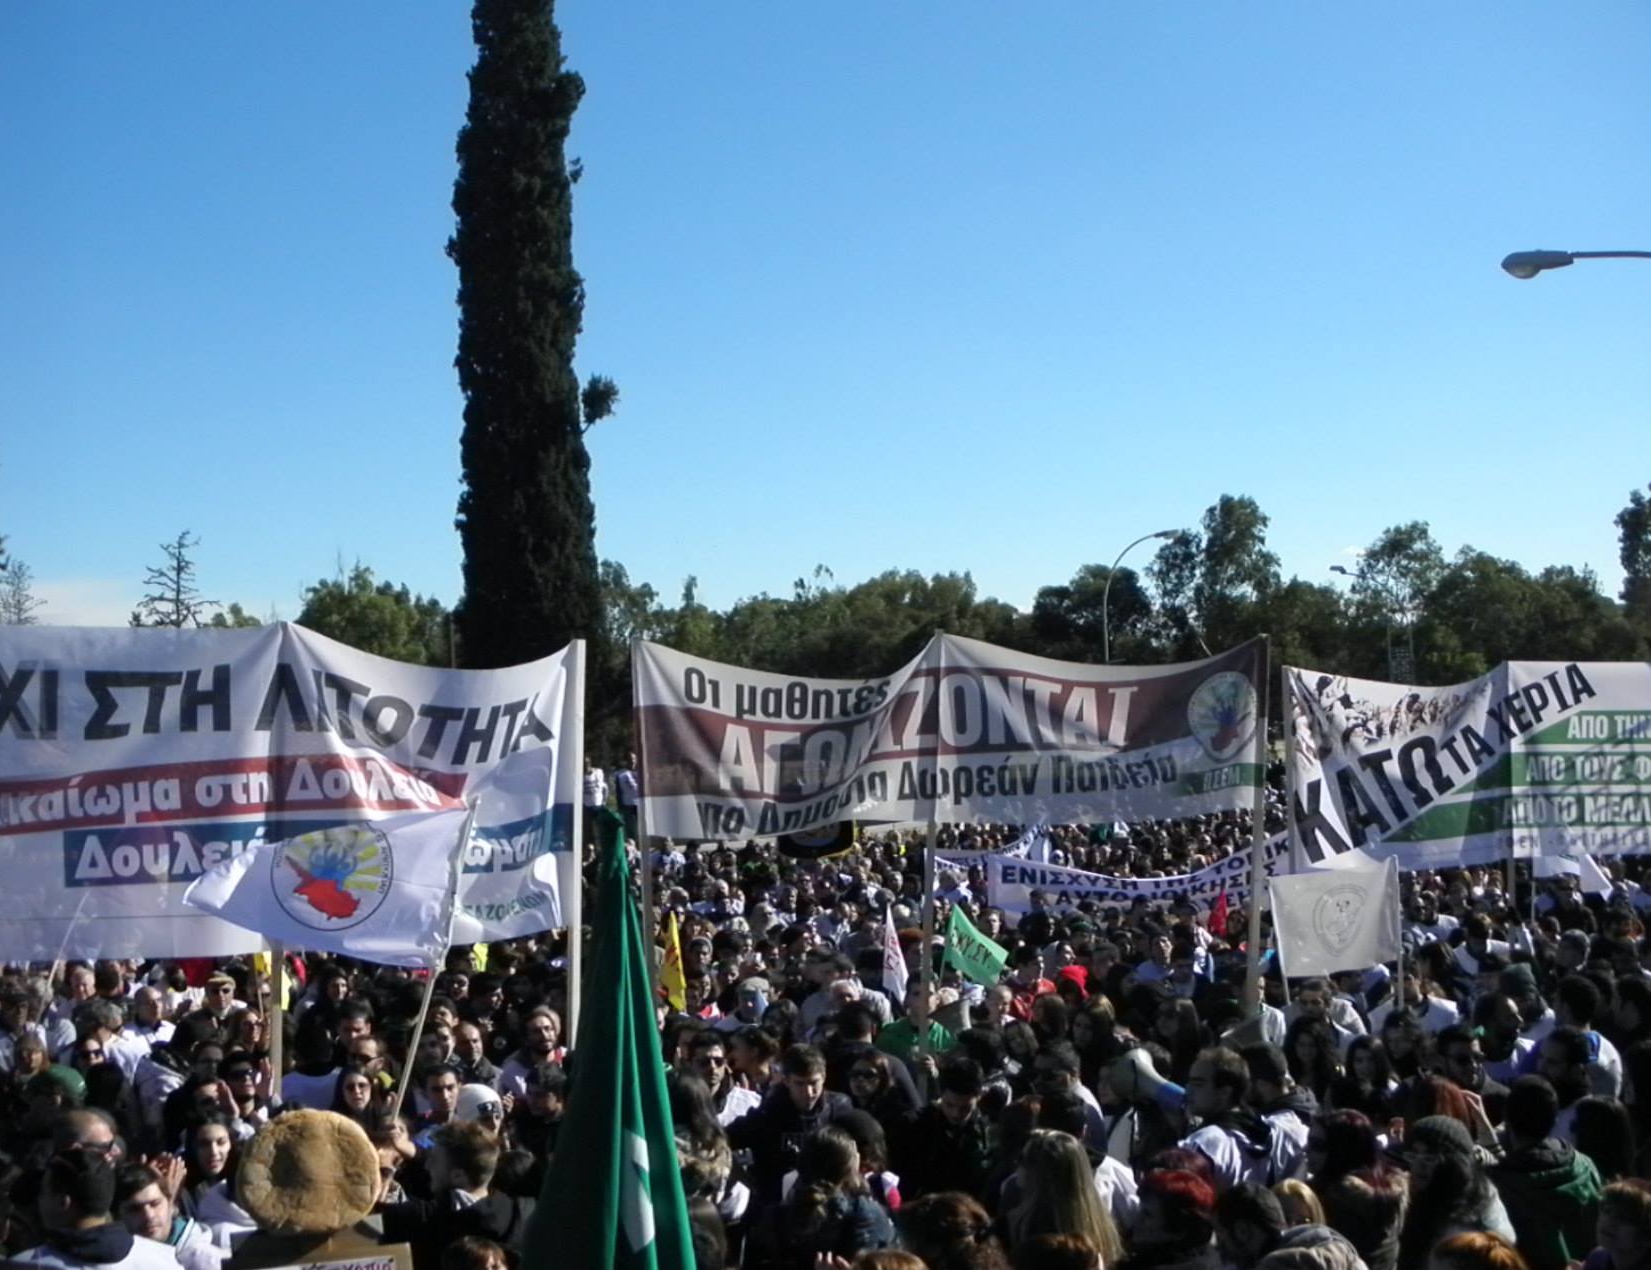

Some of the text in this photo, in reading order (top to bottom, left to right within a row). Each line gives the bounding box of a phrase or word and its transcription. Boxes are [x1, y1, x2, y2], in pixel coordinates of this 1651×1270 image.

[84, 663, 231, 740] ΣΤΗ
[735, 679, 891, 720] μαθητές
[1566, 714, 1609, 739] ΑΠΟ
[898, 755, 1041, 806] Δωρεάν
[1051, 752, 1177, 796] Παιδεία
[1295, 663, 1598, 863] ΚΑΤΩ ΤΑ ΧΕΡΙΑ
[195, 771, 271, 807] στη
